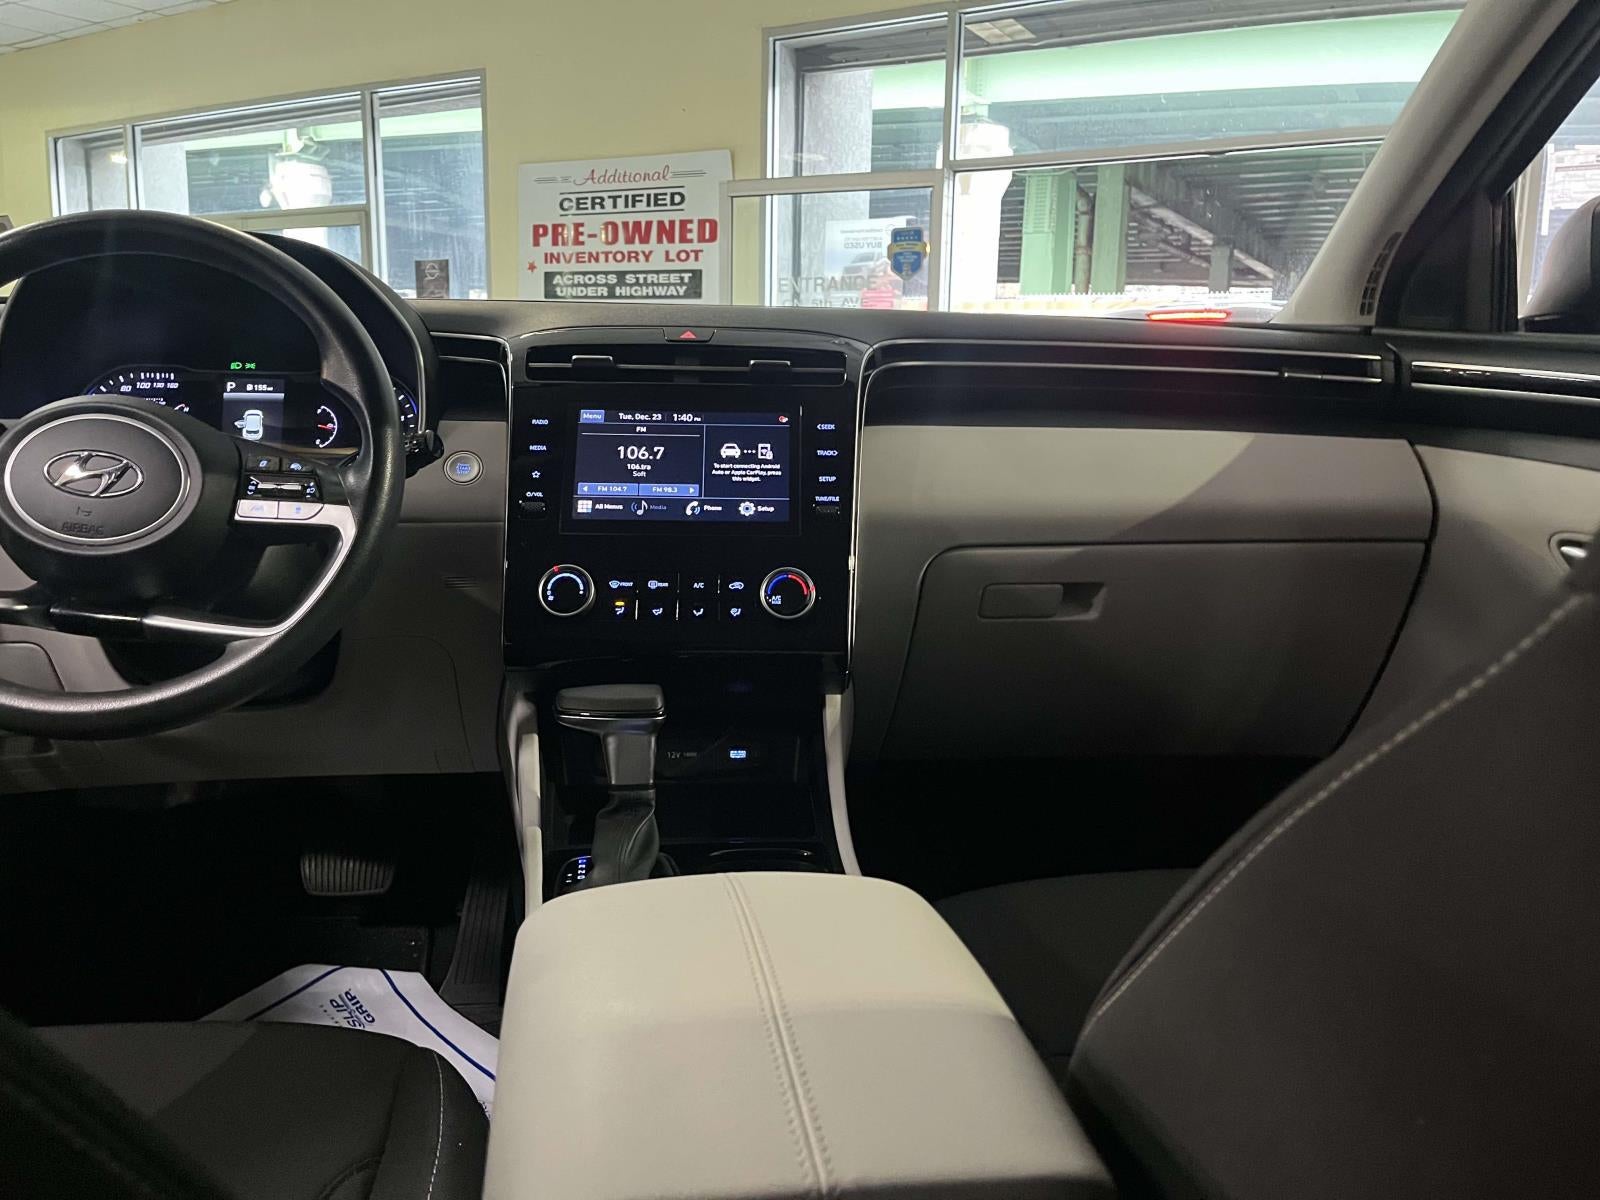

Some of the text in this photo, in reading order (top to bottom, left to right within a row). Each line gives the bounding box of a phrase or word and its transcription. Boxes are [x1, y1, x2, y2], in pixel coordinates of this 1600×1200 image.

[573, 165, 671, 185] Additional
[559, 191, 686, 212] CERTIFIED
[532, 218, 719, 247] PRE-OWNED
[544, 249, 704, 264] INVENTORY LOT
[552, 273, 693, 285] ACROSS STREET
[778, 275, 879, 293] ENTRANCE
[554, 286, 688, 297] UNDER HIGHWAY
[226, 382, 236, 392] P
[619, 413, 662, 421] Tue, Dec. 23
[673, 413, 693, 422] 1:40
[617, 445, 665, 460] 106.7
[632, 470, 647, 478] Soft
[61, 521, 104, 536] AIRBAG
[345, 991, 376, 1024] GRIP
